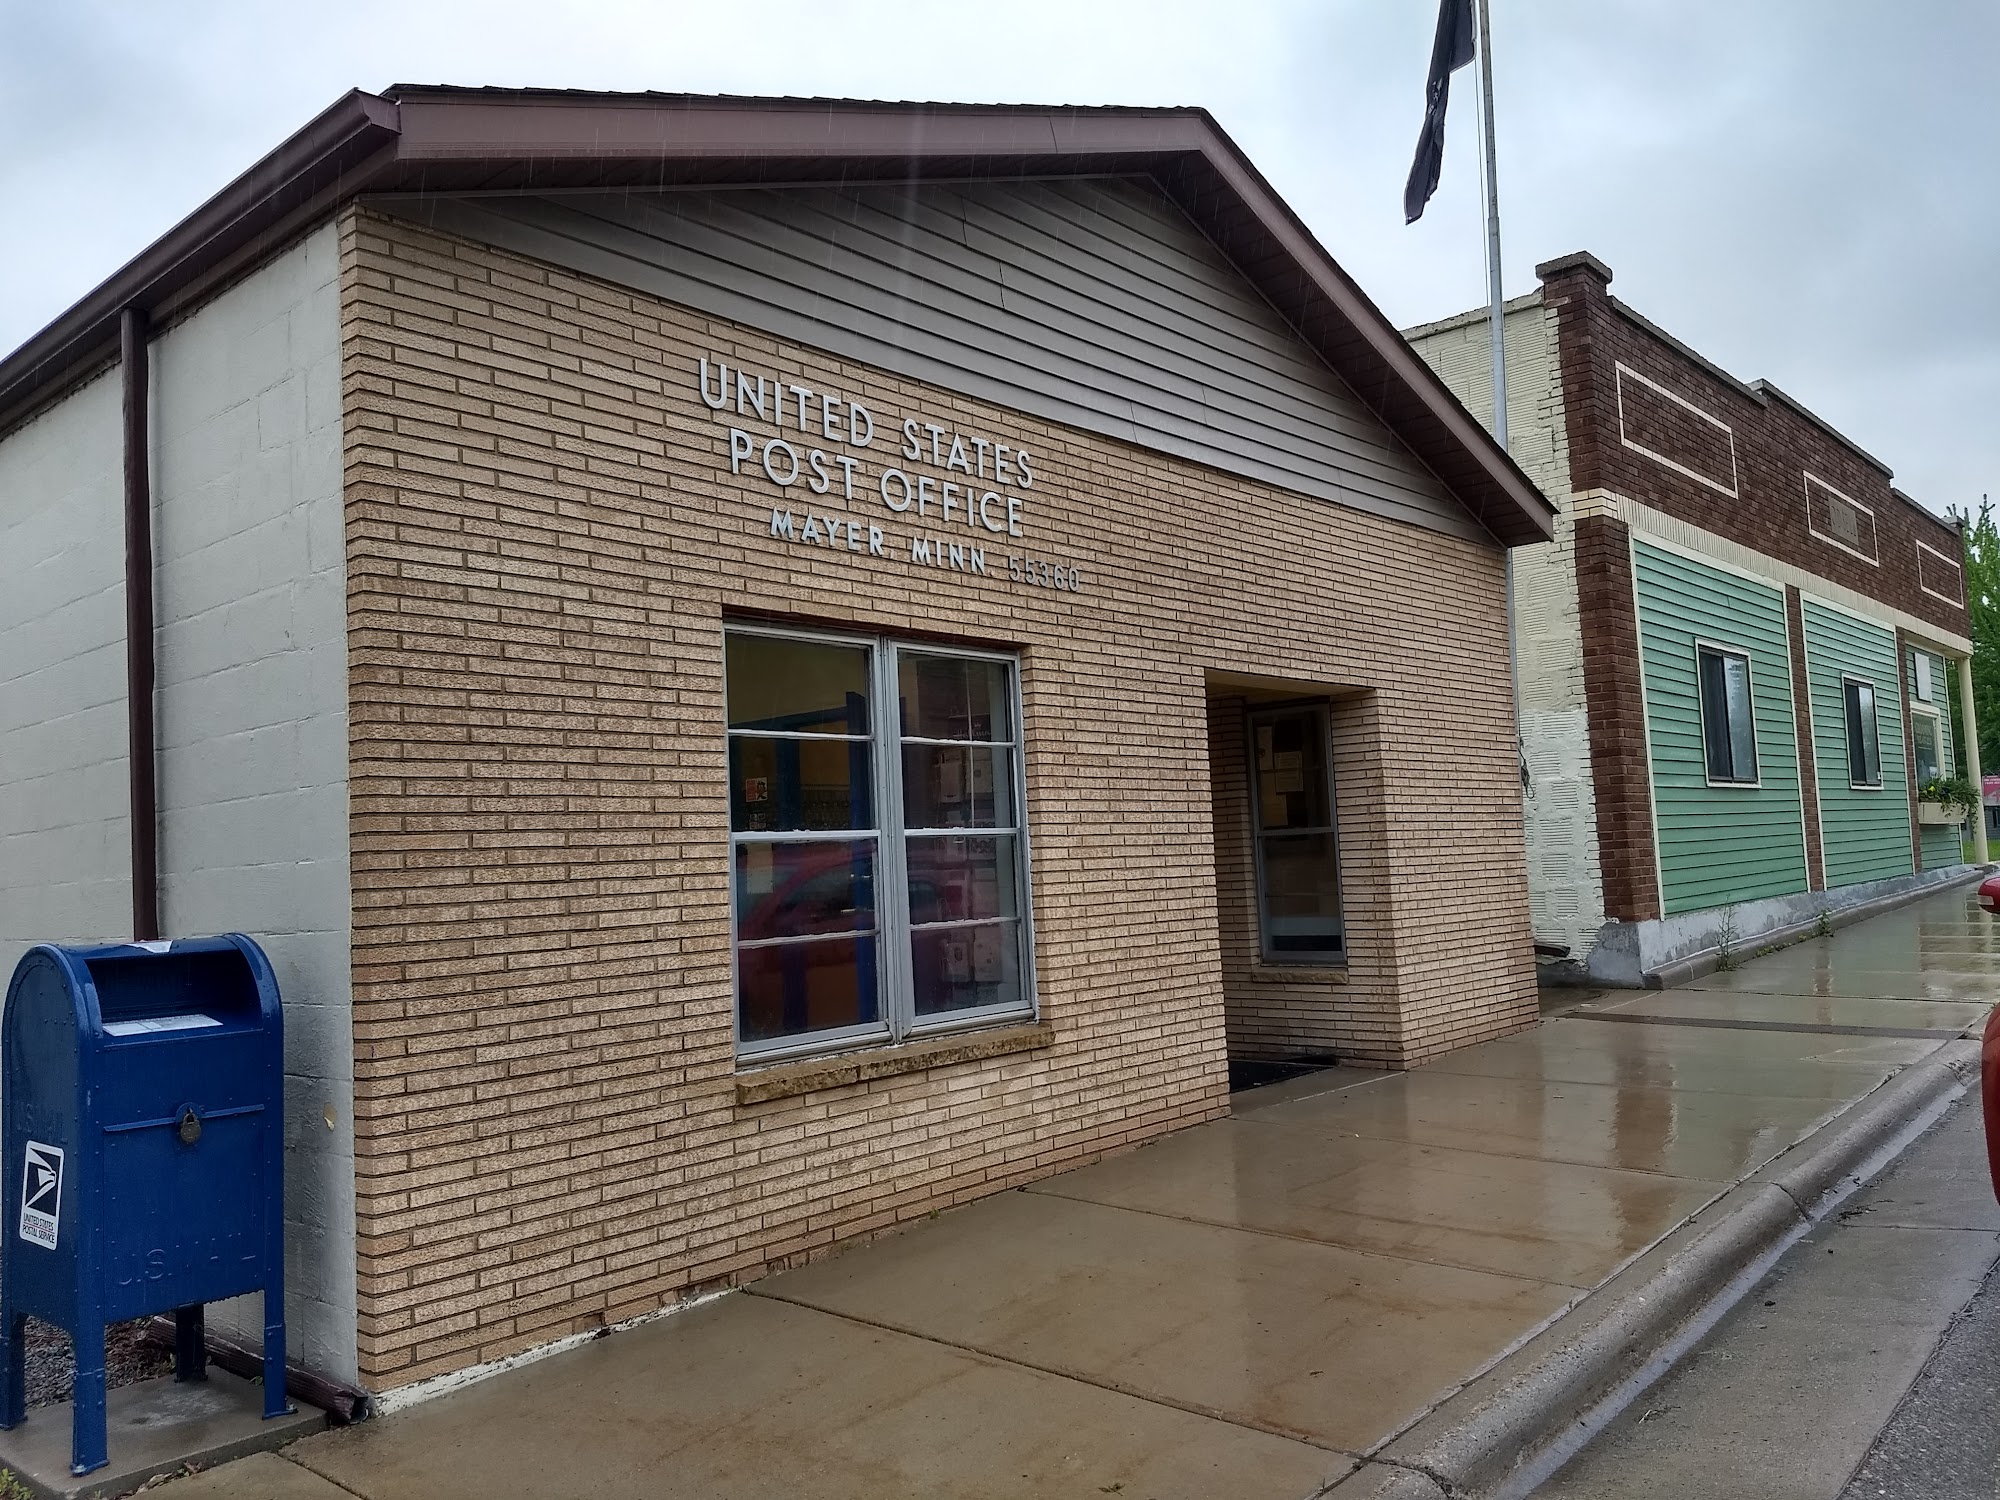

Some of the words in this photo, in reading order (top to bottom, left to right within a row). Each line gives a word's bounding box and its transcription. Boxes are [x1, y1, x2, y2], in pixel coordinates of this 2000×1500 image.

[700, 357, 873, 447] UNITED
[902, 418, 1032, 489] STATES
[730, 428, 858, 500] POST
[881, 468, 1023, 537] OFFICE
[1008, 555, 1080, 592] 55360
[22, 1224, 38, 1237] POSTAL
[38, 1229, 55, 1244] SERVICE
[23, 1213, 39, 1226] UNITED
[39, 1218, 54, 1231] STATES
